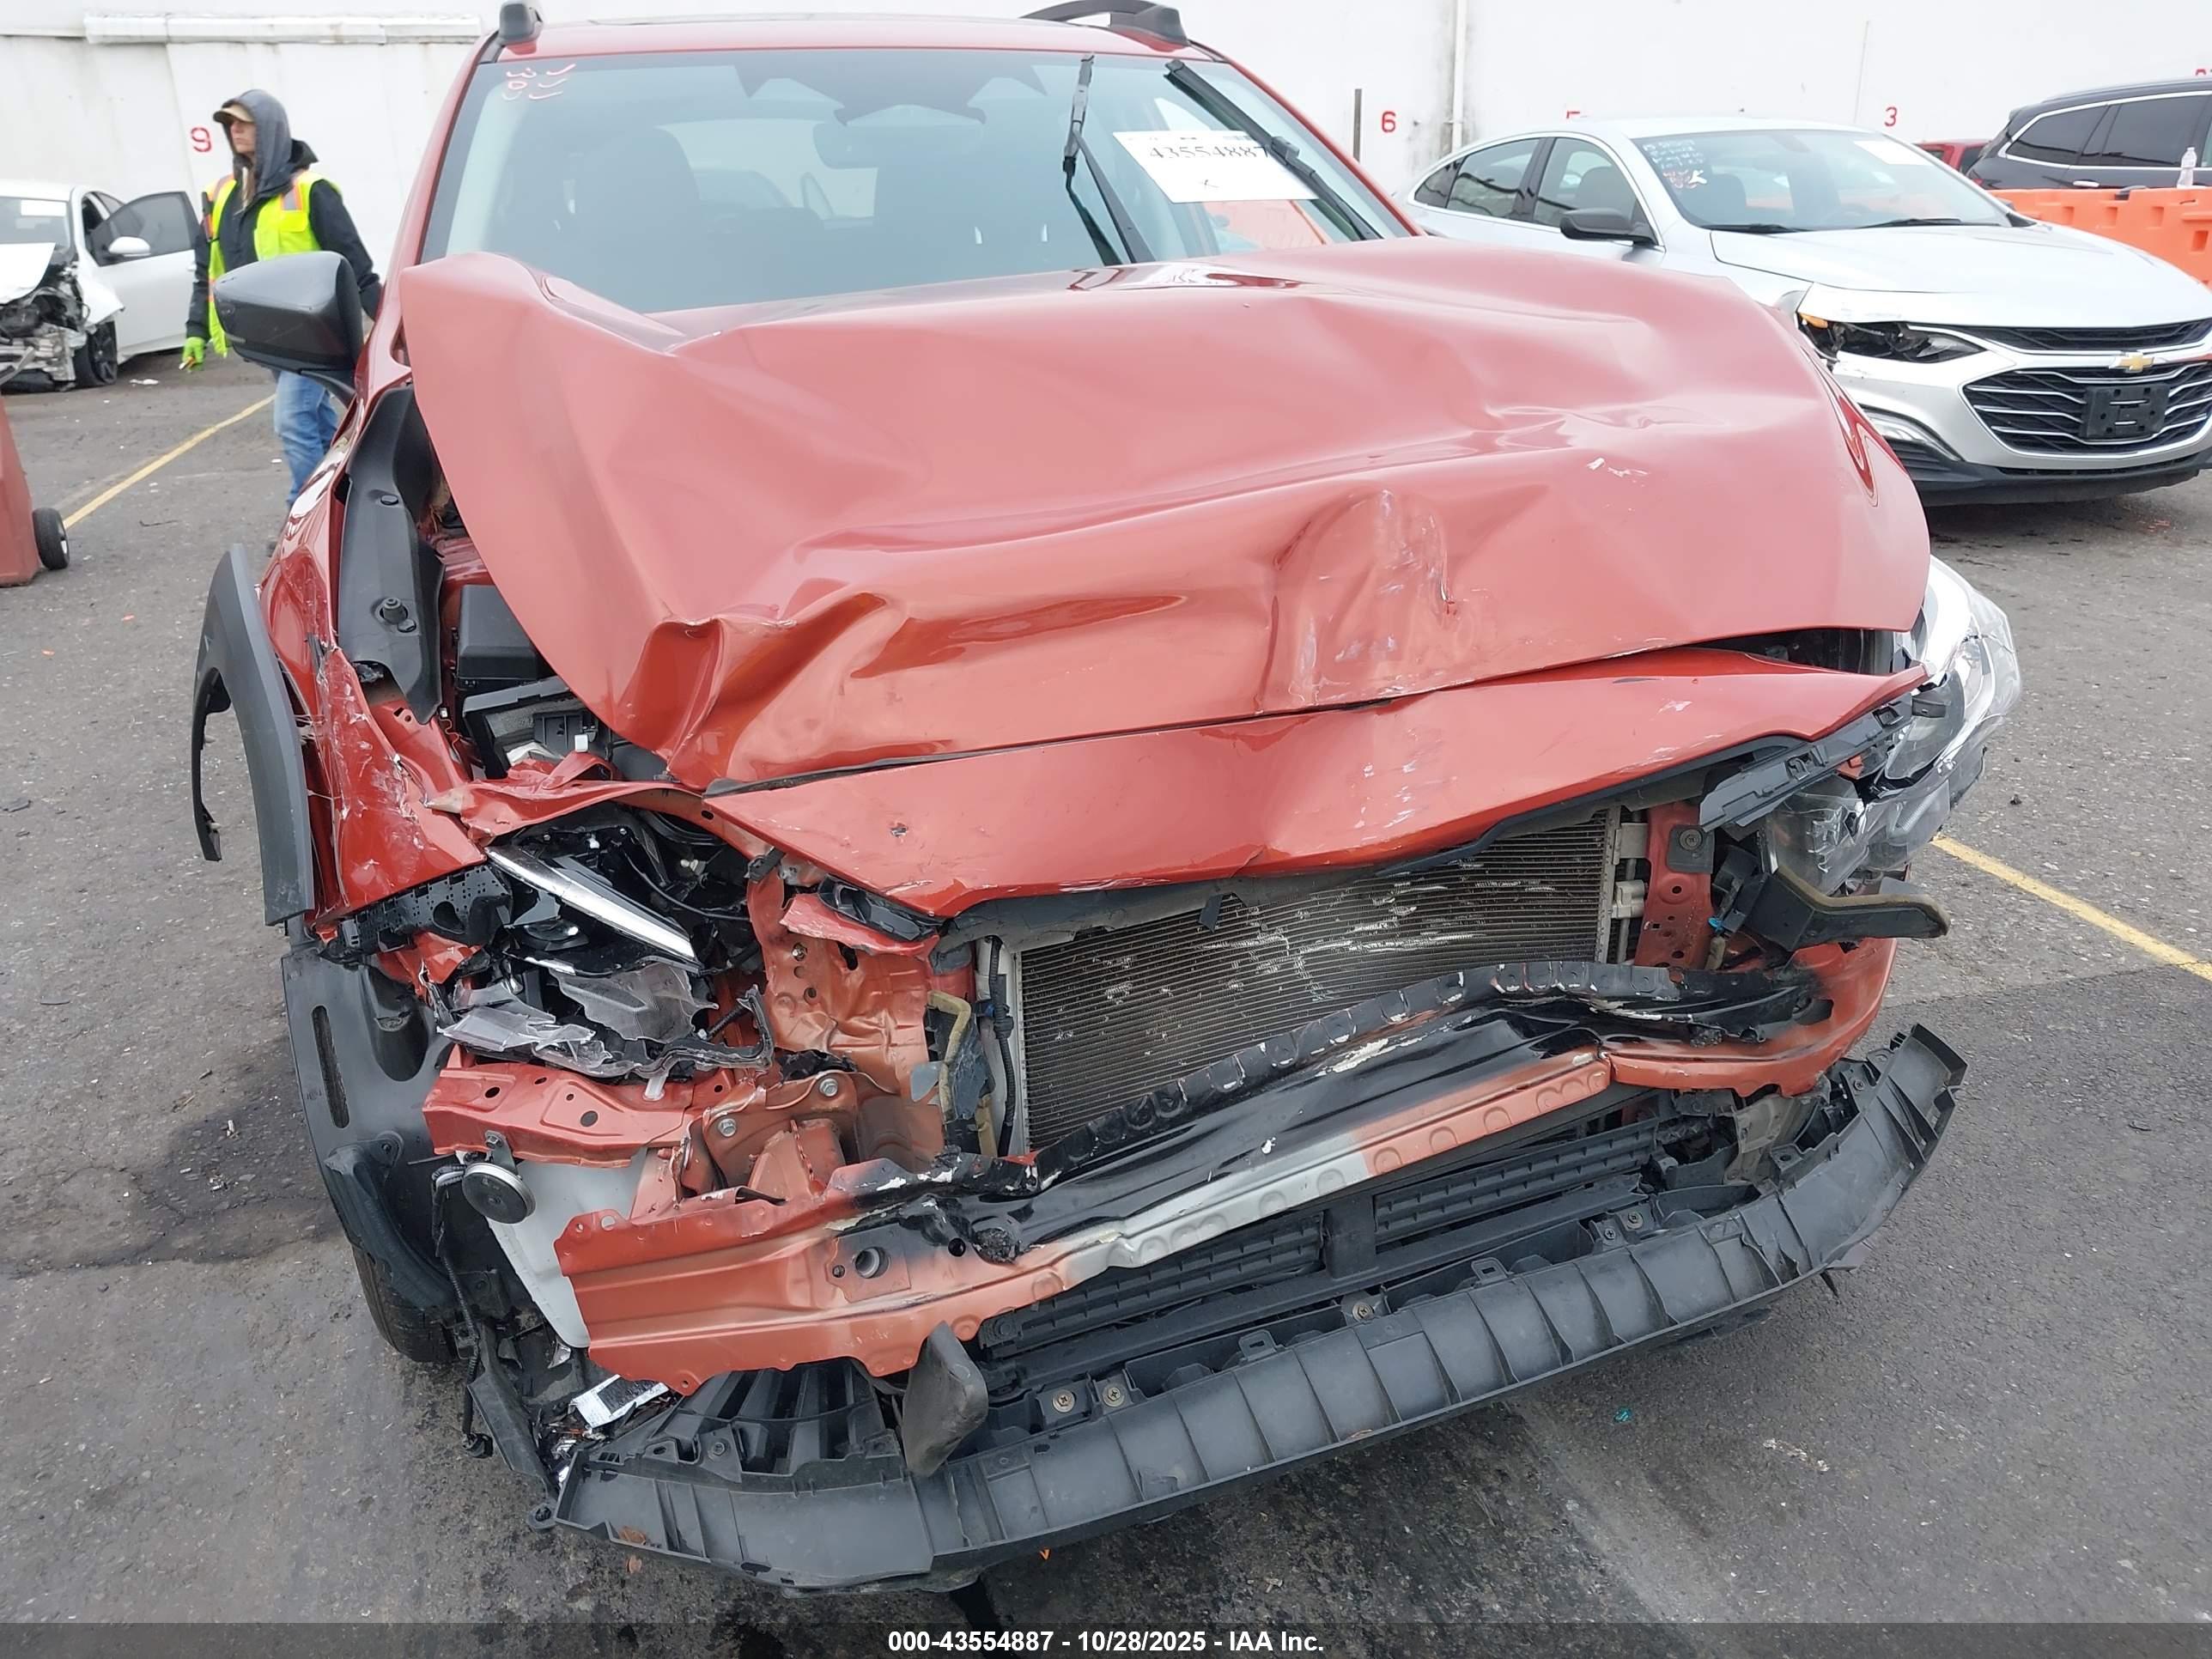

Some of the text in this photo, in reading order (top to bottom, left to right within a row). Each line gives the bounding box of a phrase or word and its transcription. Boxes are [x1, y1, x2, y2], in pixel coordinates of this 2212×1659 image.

[1382, 111, 1396, 133] 6
[1884, 106, 1898, 127] 3
[191, 127, 212, 152] 9
